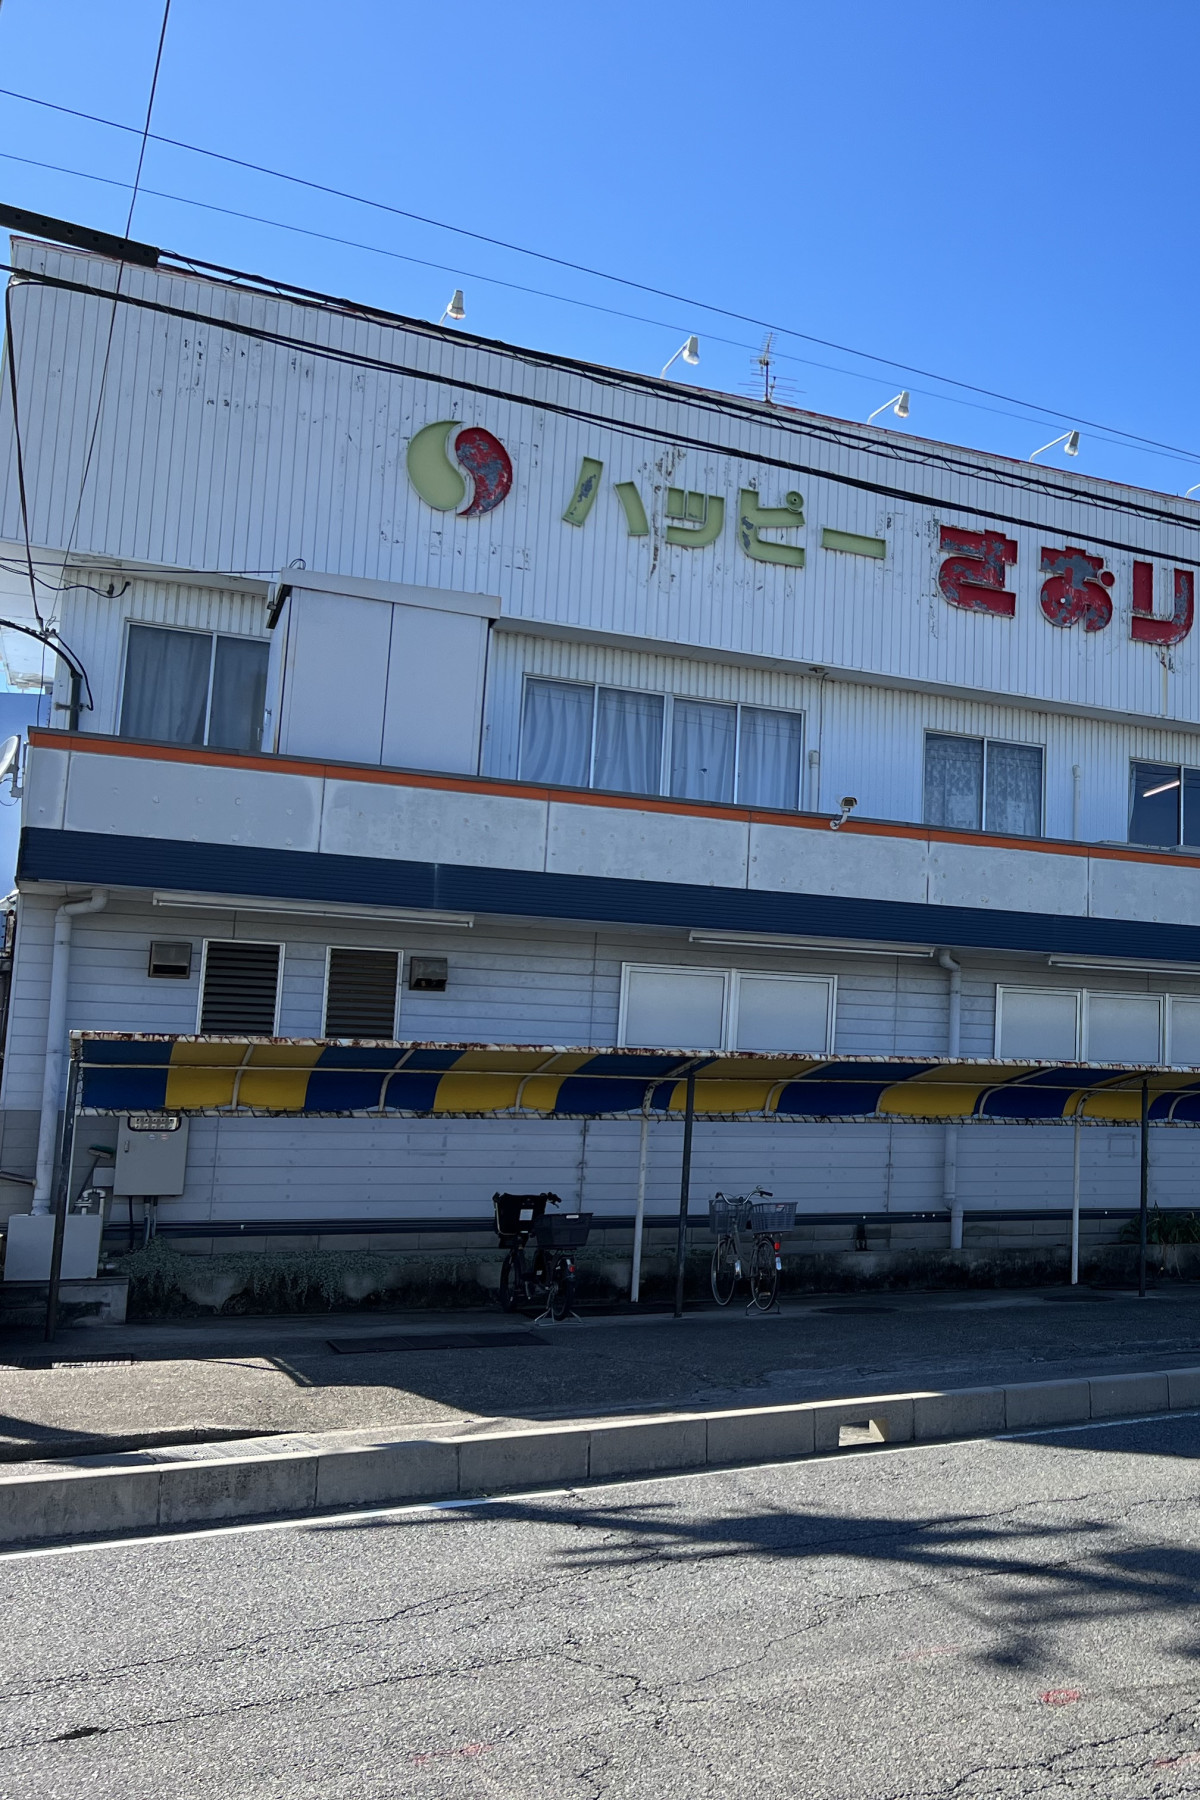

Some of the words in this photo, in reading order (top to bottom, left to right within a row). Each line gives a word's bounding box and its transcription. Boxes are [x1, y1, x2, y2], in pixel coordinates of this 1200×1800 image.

[561, 456, 887, 568] ハッピー
[938, 523, 1196, 646] さおり
